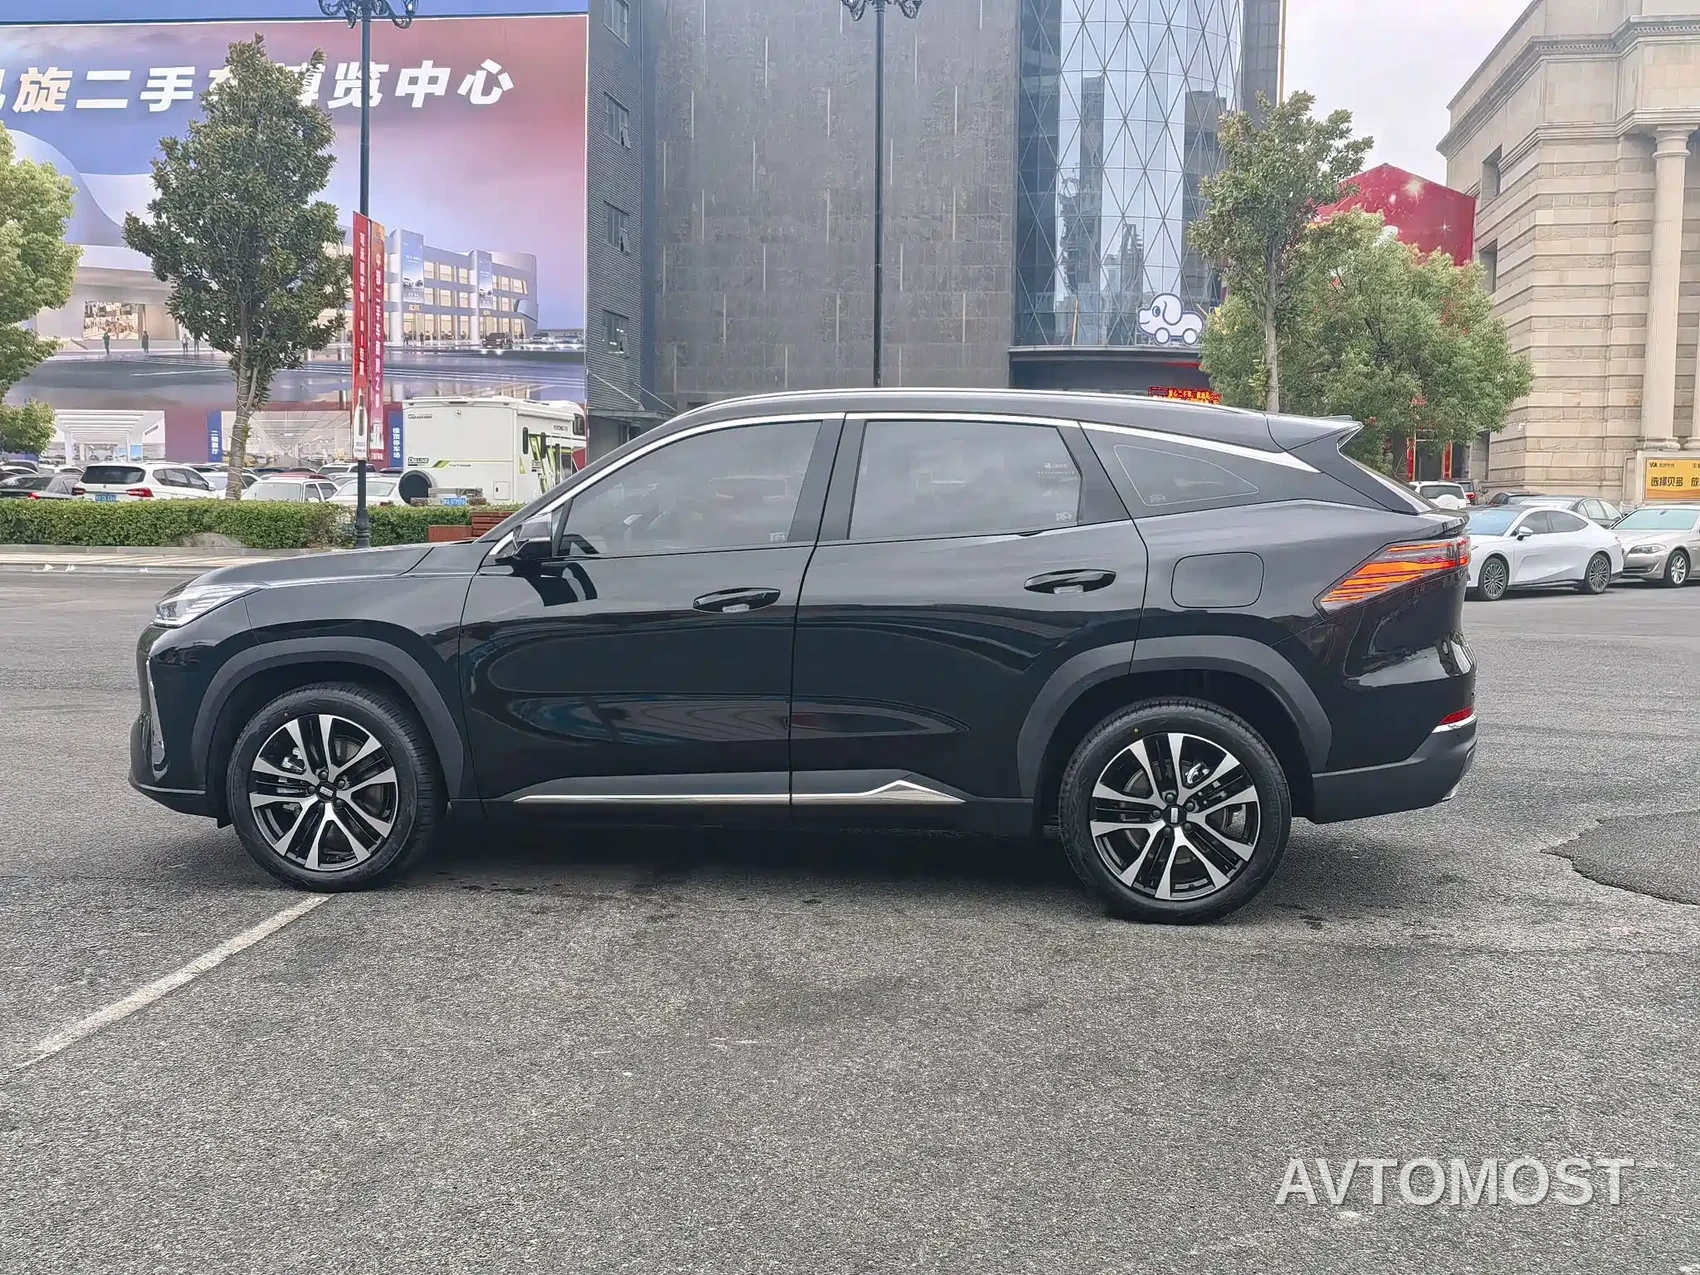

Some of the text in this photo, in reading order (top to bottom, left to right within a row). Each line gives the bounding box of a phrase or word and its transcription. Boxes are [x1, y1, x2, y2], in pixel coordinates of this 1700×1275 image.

[0, 58, 515, 113] 旋二手览中心
